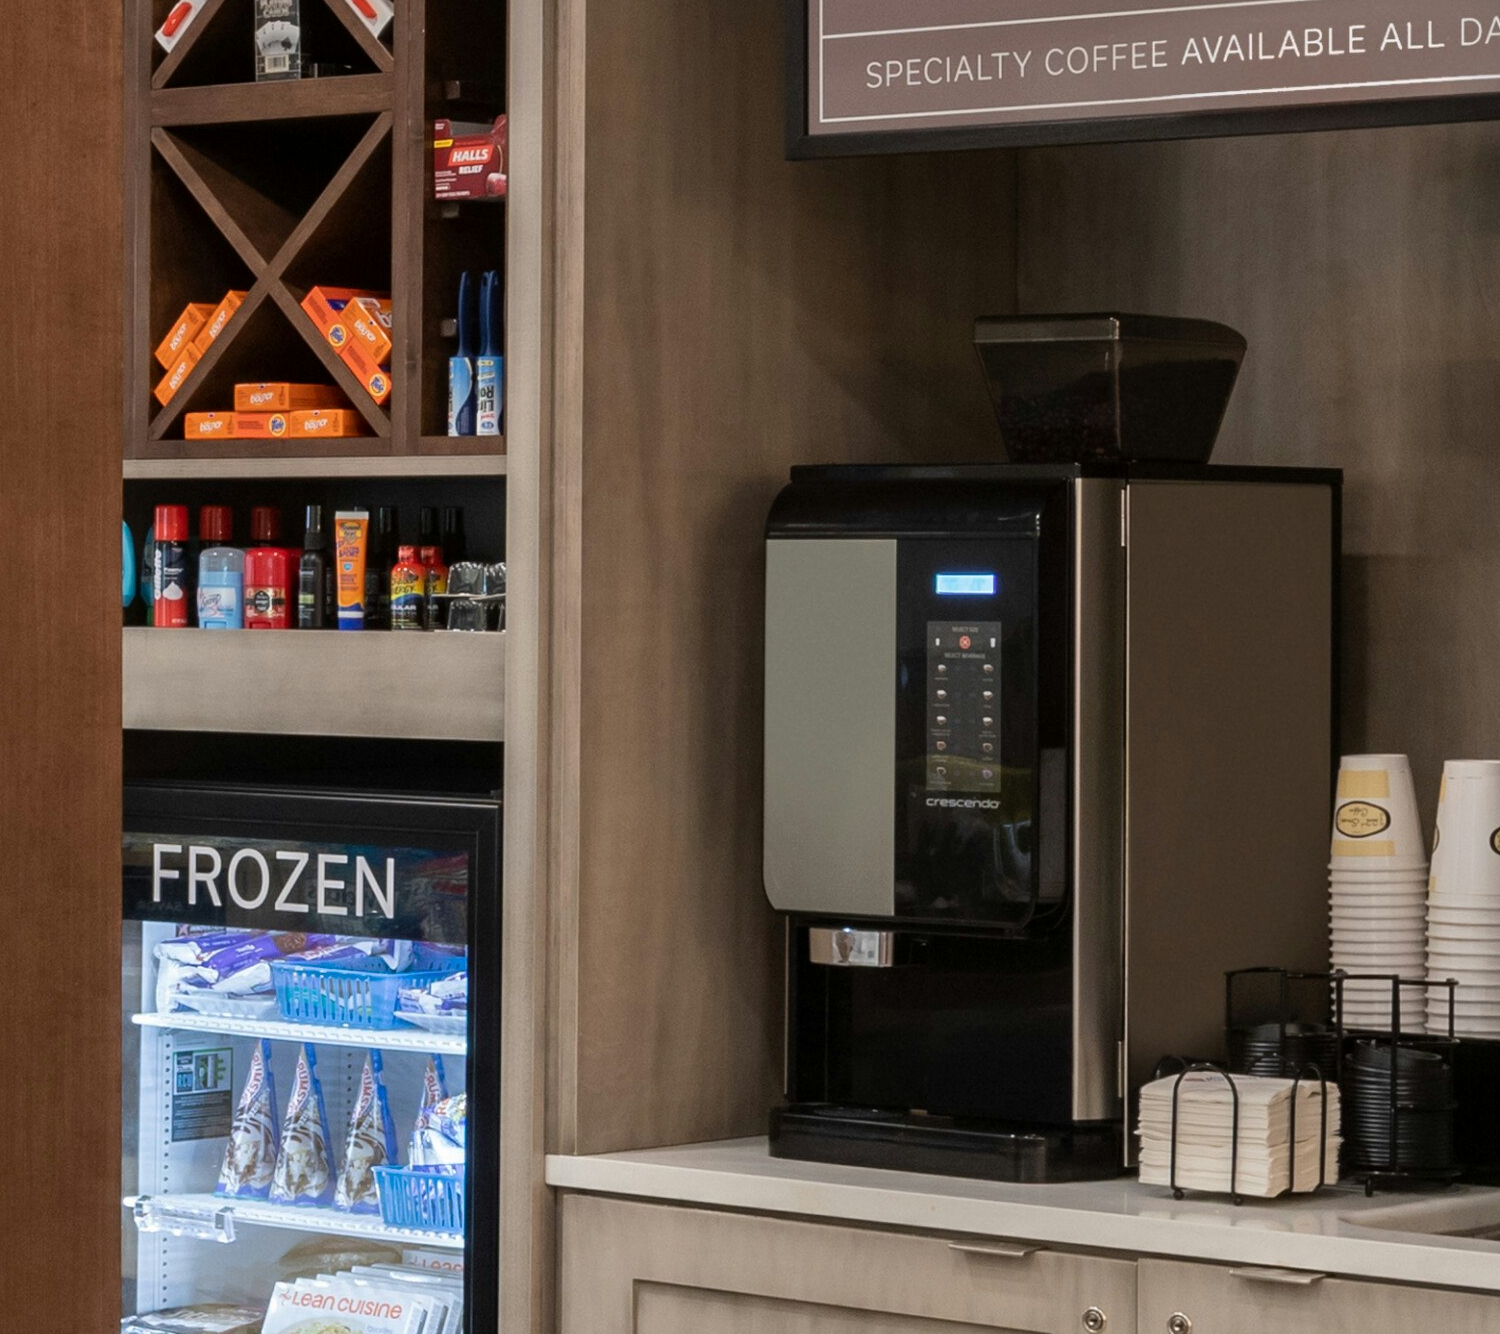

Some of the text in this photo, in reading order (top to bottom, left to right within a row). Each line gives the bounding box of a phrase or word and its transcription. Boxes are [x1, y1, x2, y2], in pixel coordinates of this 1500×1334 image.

[866, 50, 1032, 89] SPECIALTY
[1045, 40, 1167, 76] COFFEE
[1182, 24, 1366, 66] AVAILABLE
[1381, 21, 1444, 51] ALL
[452, 149, 488, 162] HALLS
[926, 797, 1000, 809] crescendo
[151, 843, 395, 919] FROZEN
